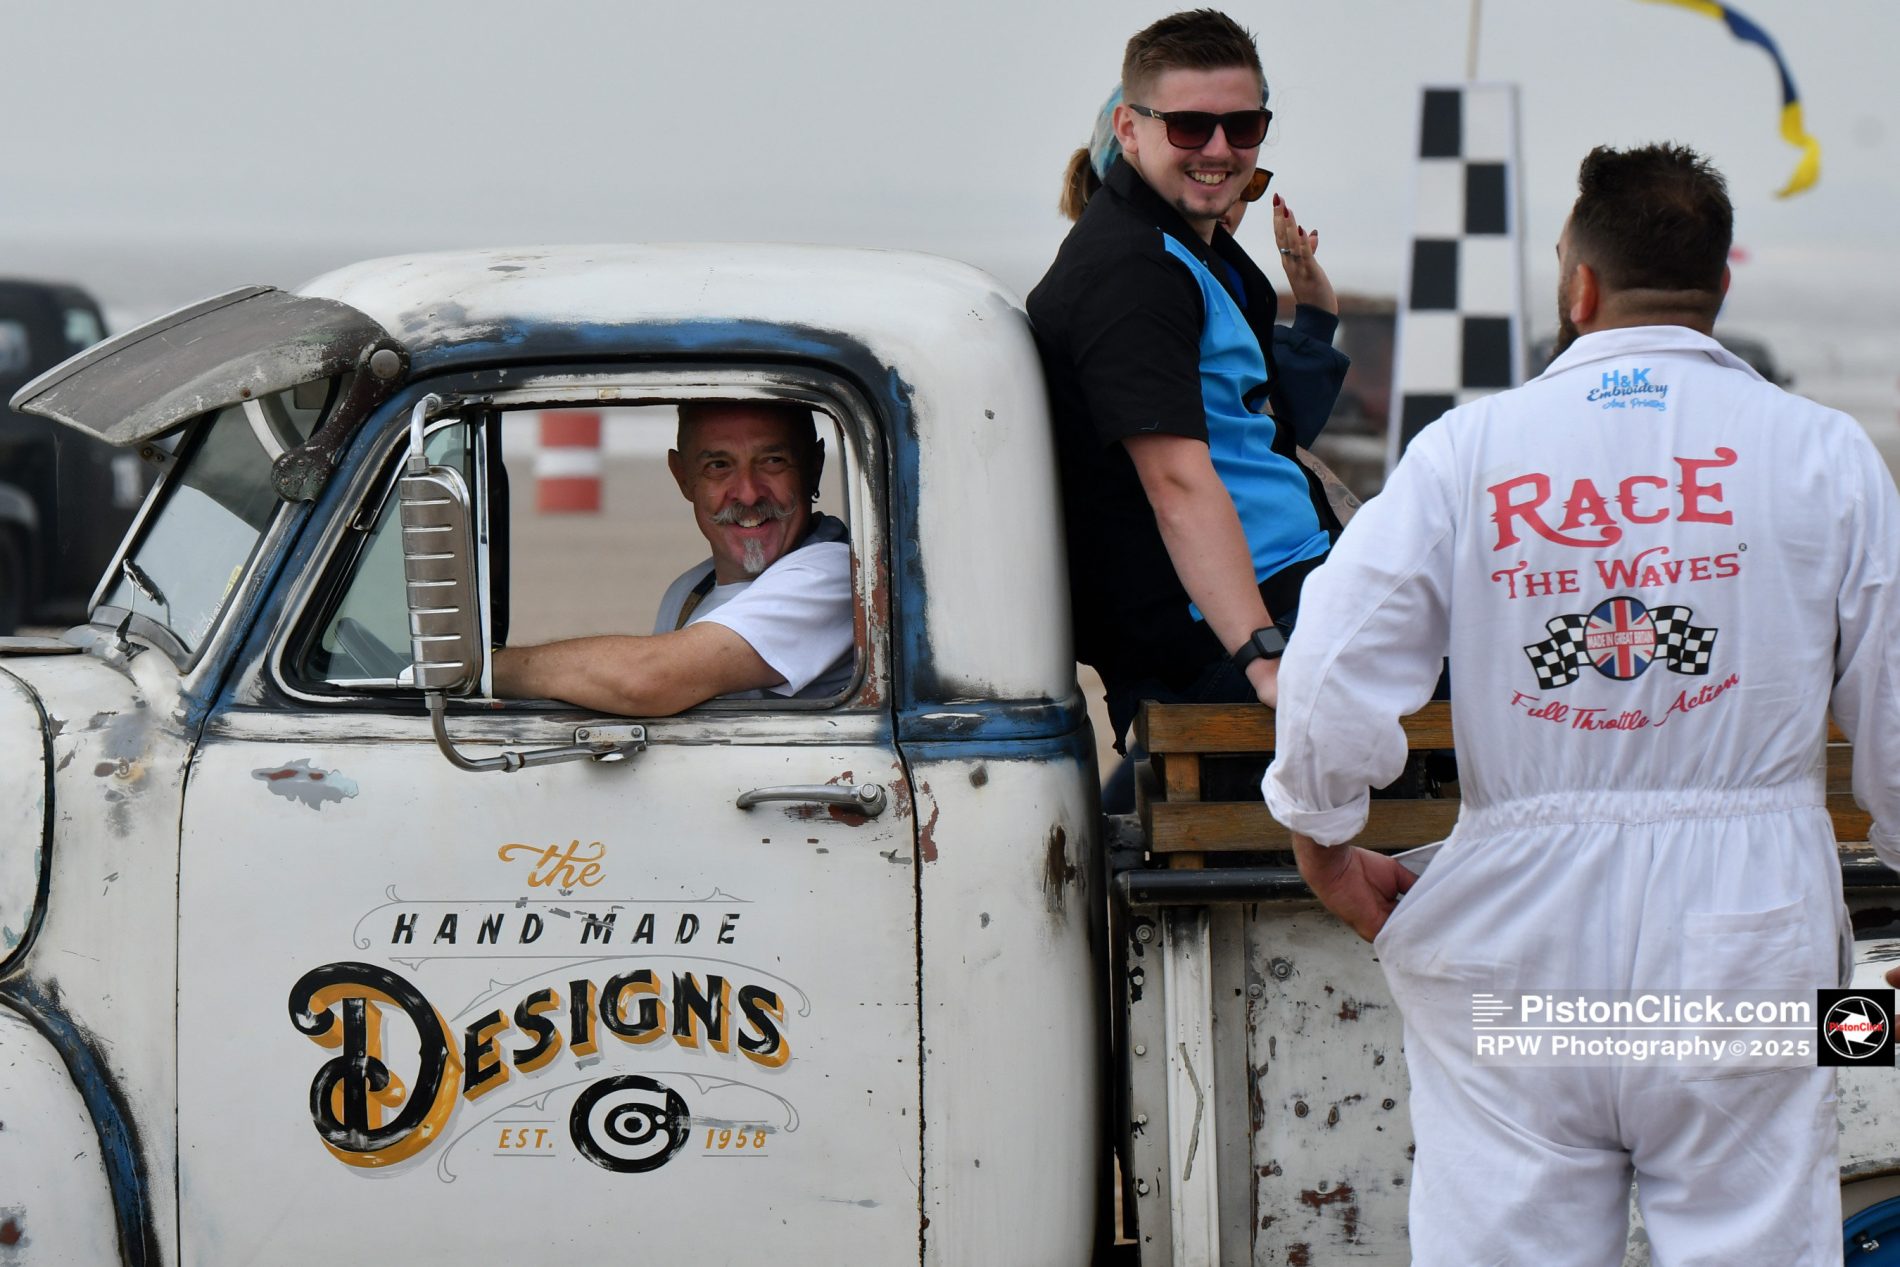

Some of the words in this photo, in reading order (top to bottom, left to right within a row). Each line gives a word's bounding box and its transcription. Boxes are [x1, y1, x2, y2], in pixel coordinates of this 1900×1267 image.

[1587, 383, 1668, 401] Embroidery
[1602, 368, 1651, 389] H&K
[1487, 447, 1738, 551] RACE
[1491, 561, 1580, 599] THE
[1595, 546, 1740, 589] WAVES
[1510, 689, 1569, 723] Full
[1572, 708, 1650, 731] Throttle
[1654, 672, 1741, 727] Action
[498, 840, 607, 889] the
[391, 913, 545, 945] HAND
[580, 912, 741, 945] MADE
[288, 961, 793, 1169] DESIGNS
[499, 1129, 553, 1149] EST.
[705, 1129, 767, 1149] 1958
